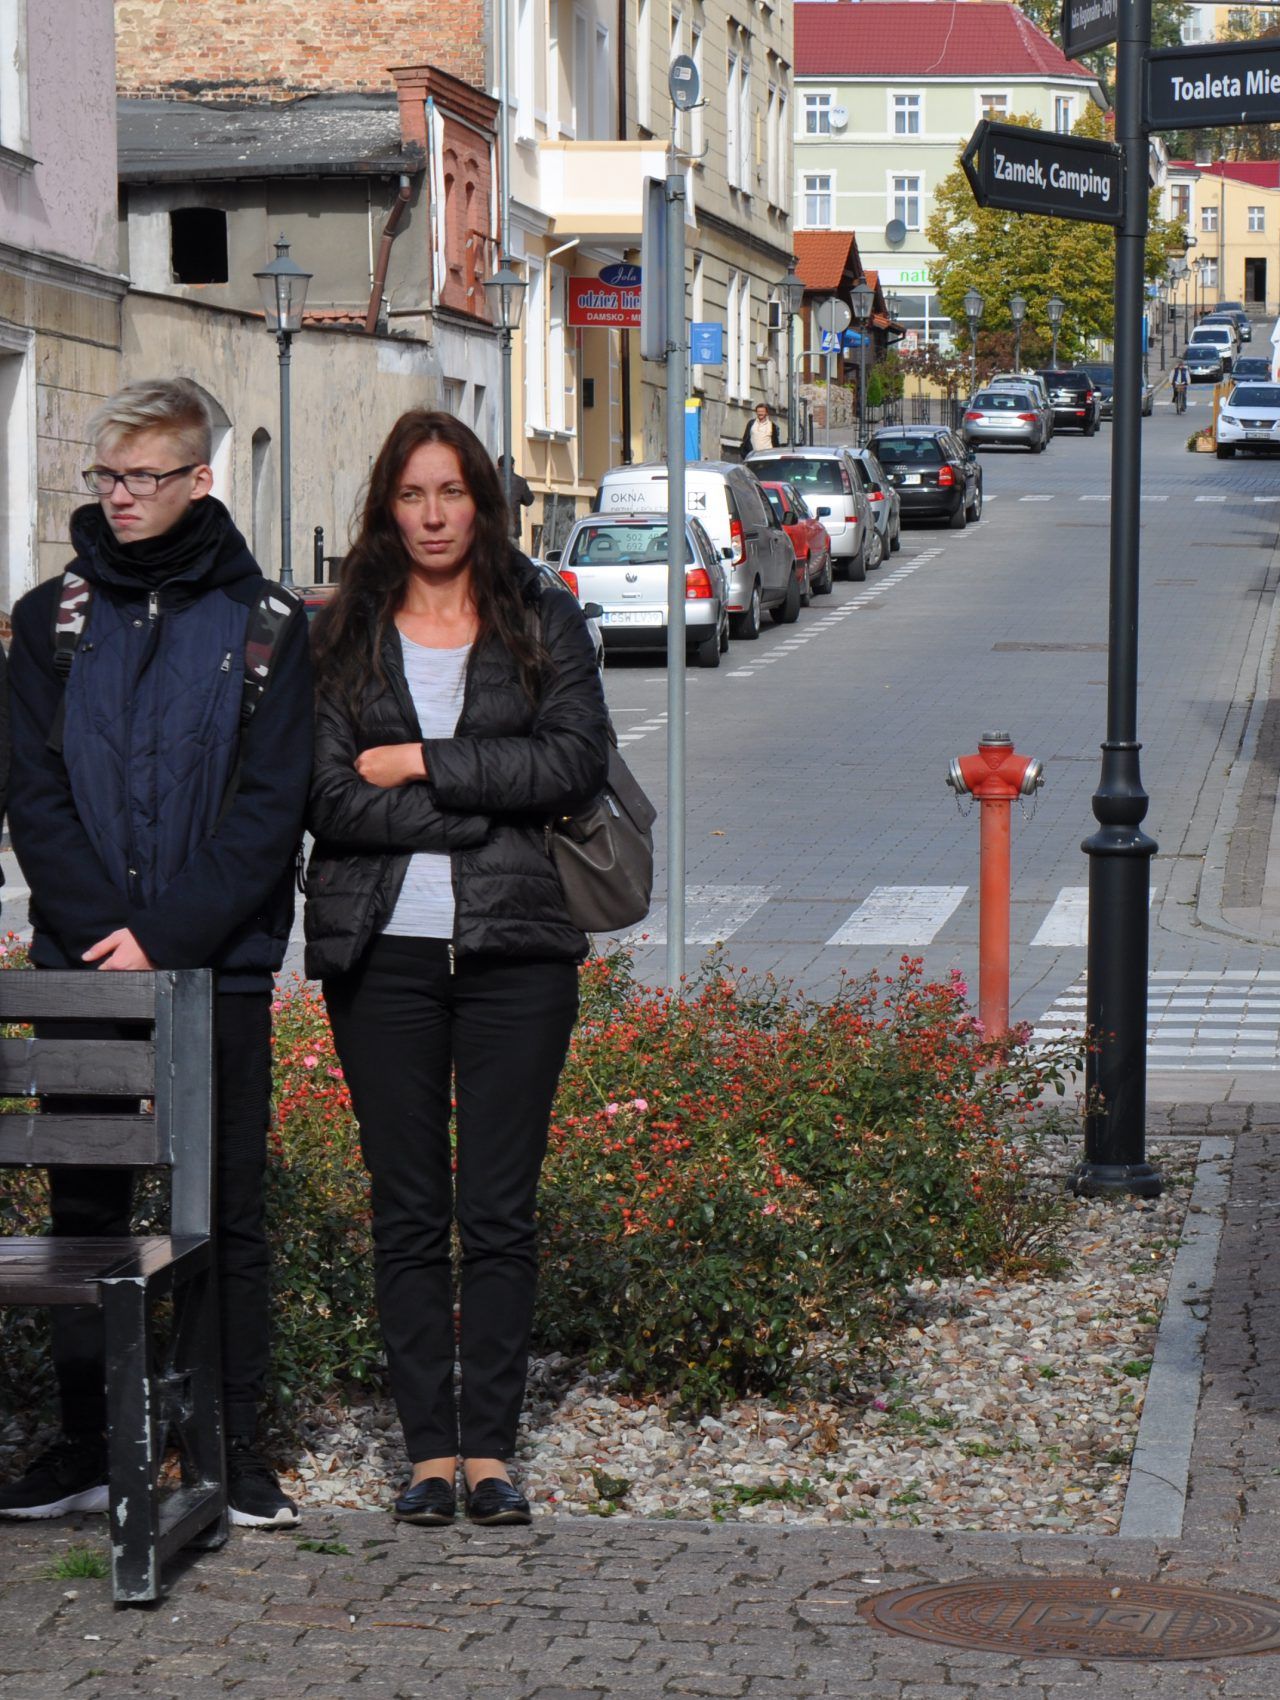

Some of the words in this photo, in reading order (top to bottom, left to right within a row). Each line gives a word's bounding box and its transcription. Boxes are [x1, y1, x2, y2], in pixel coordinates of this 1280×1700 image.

[1171, 74, 1241, 101] Toaleta
[995, 154, 1047, 190] Zamek,
[1050, 163, 1111, 201] Camping
[610, 266, 636, 285] Jola
[900, 269, 929, 282] nat
[578, 290, 619, 309] odzież
[621, 291, 641, 310] bie
[587, 312, 625, 321] DAMSKO
[611, 492, 645, 503] OKNA
